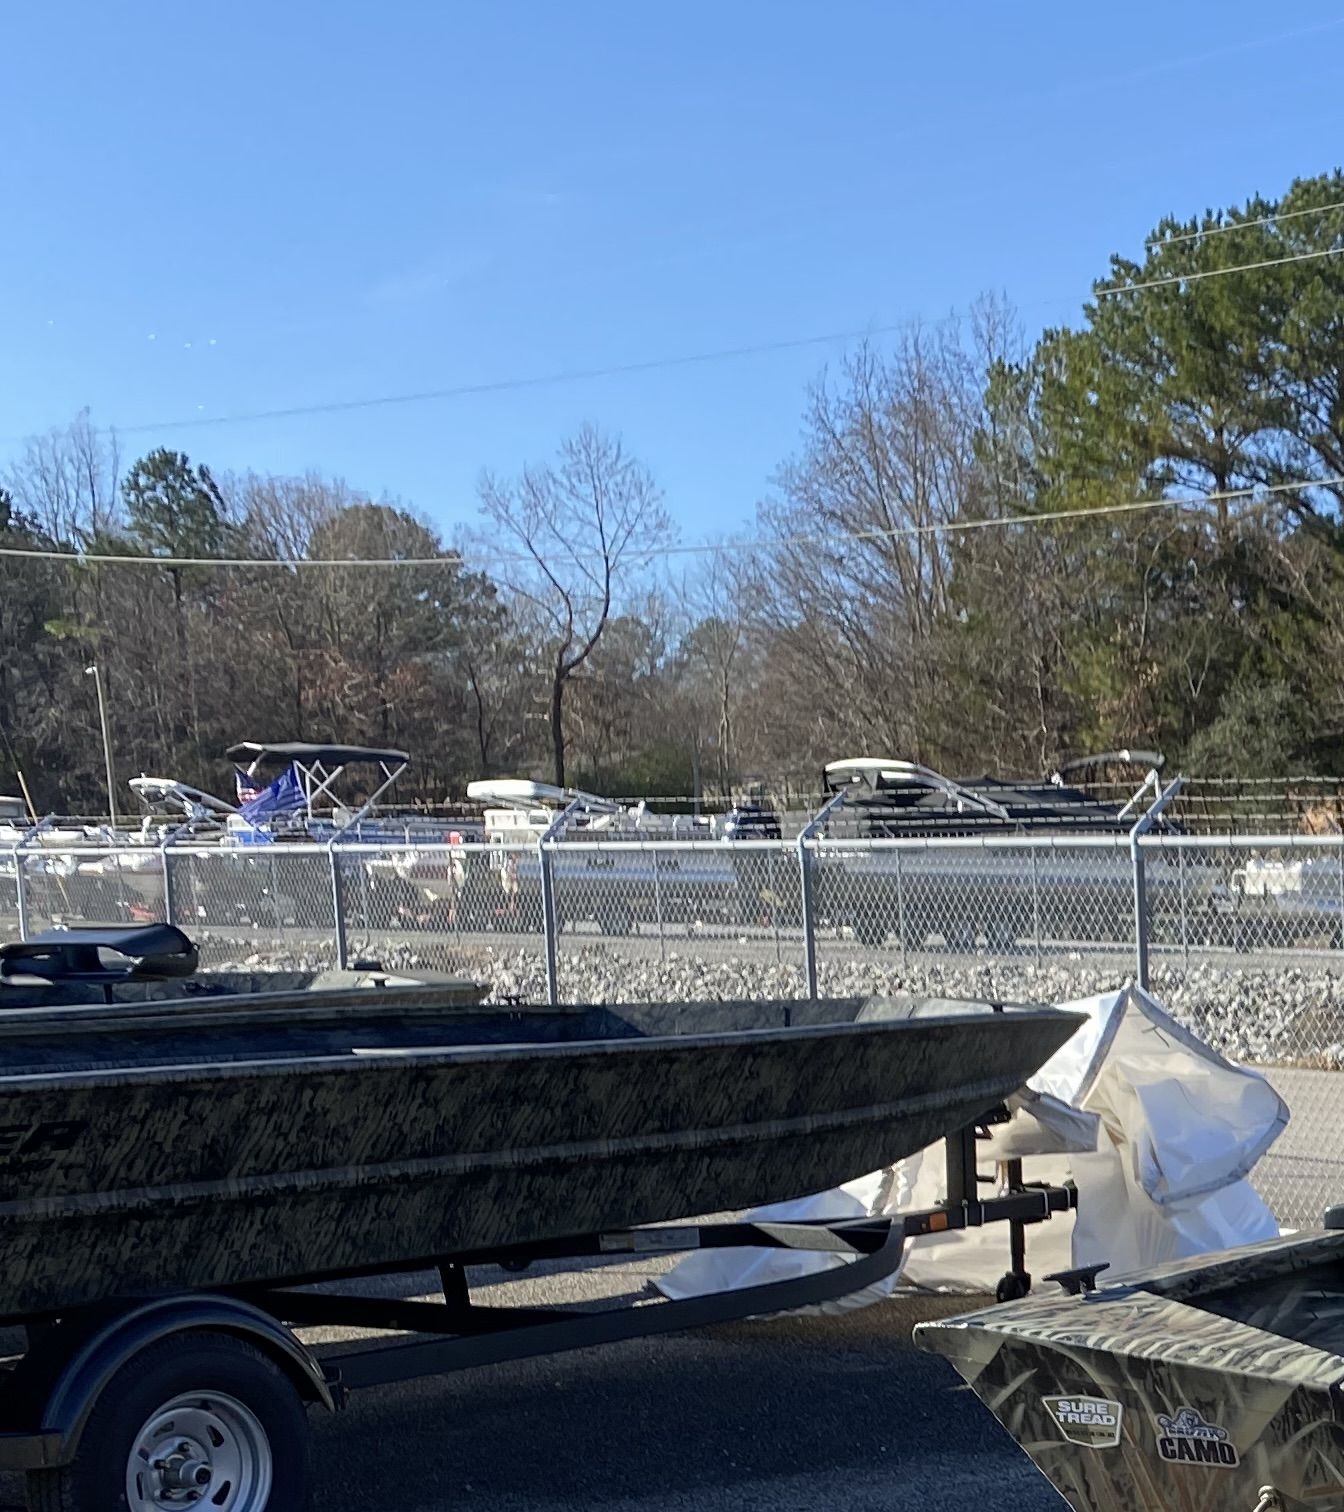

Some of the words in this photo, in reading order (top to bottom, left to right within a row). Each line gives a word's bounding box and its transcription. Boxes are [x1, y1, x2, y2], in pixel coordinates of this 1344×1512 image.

[1057, 1400, 1108, 1415] SURE
[1055, 1411, 1116, 1426] TREAD
[1160, 1437, 1237, 1465] CAMO
